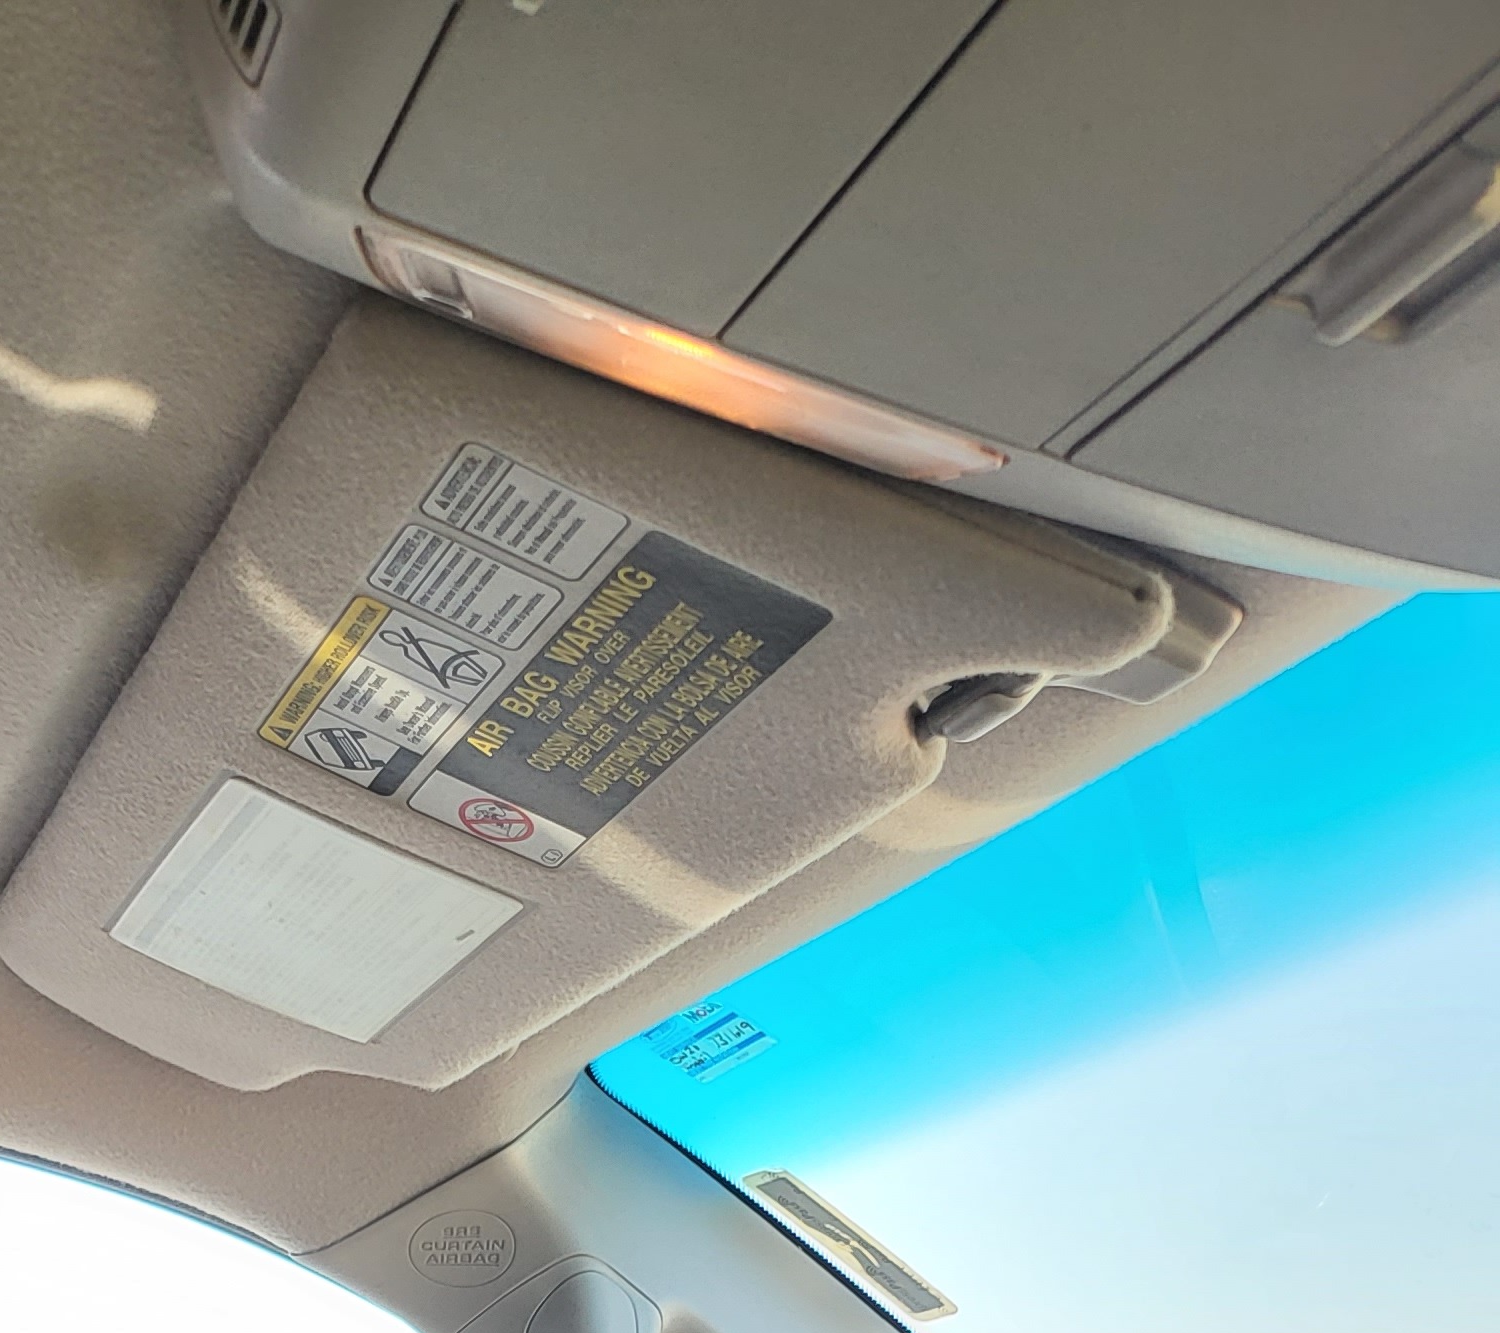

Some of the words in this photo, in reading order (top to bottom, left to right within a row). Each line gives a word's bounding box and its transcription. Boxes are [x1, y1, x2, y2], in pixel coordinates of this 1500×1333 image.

[466, 720, 515, 758] AIR
[500, 671, 560, 719] BAG
[544, 565, 657, 666] WARNING
[536, 699, 563, 724] FLIP
[559, 664, 599, 698] VISOR
[594, 629, 631, 664] OVER
[564, 723, 618, 772] REPLIER
[612, 702, 639, 724] LE
[633, 629, 714, 705] PARESOLEIL
[625, 766, 651, 788] DE
[645, 723, 699, 769] VUELTA
[694, 706, 720, 727] AL
[713, 665, 763, 704] VISOR
[636, 713, 675, 741] CON
[656, 700, 691, 722] LA
[421, 1239, 505, 1251] CURTAIN
